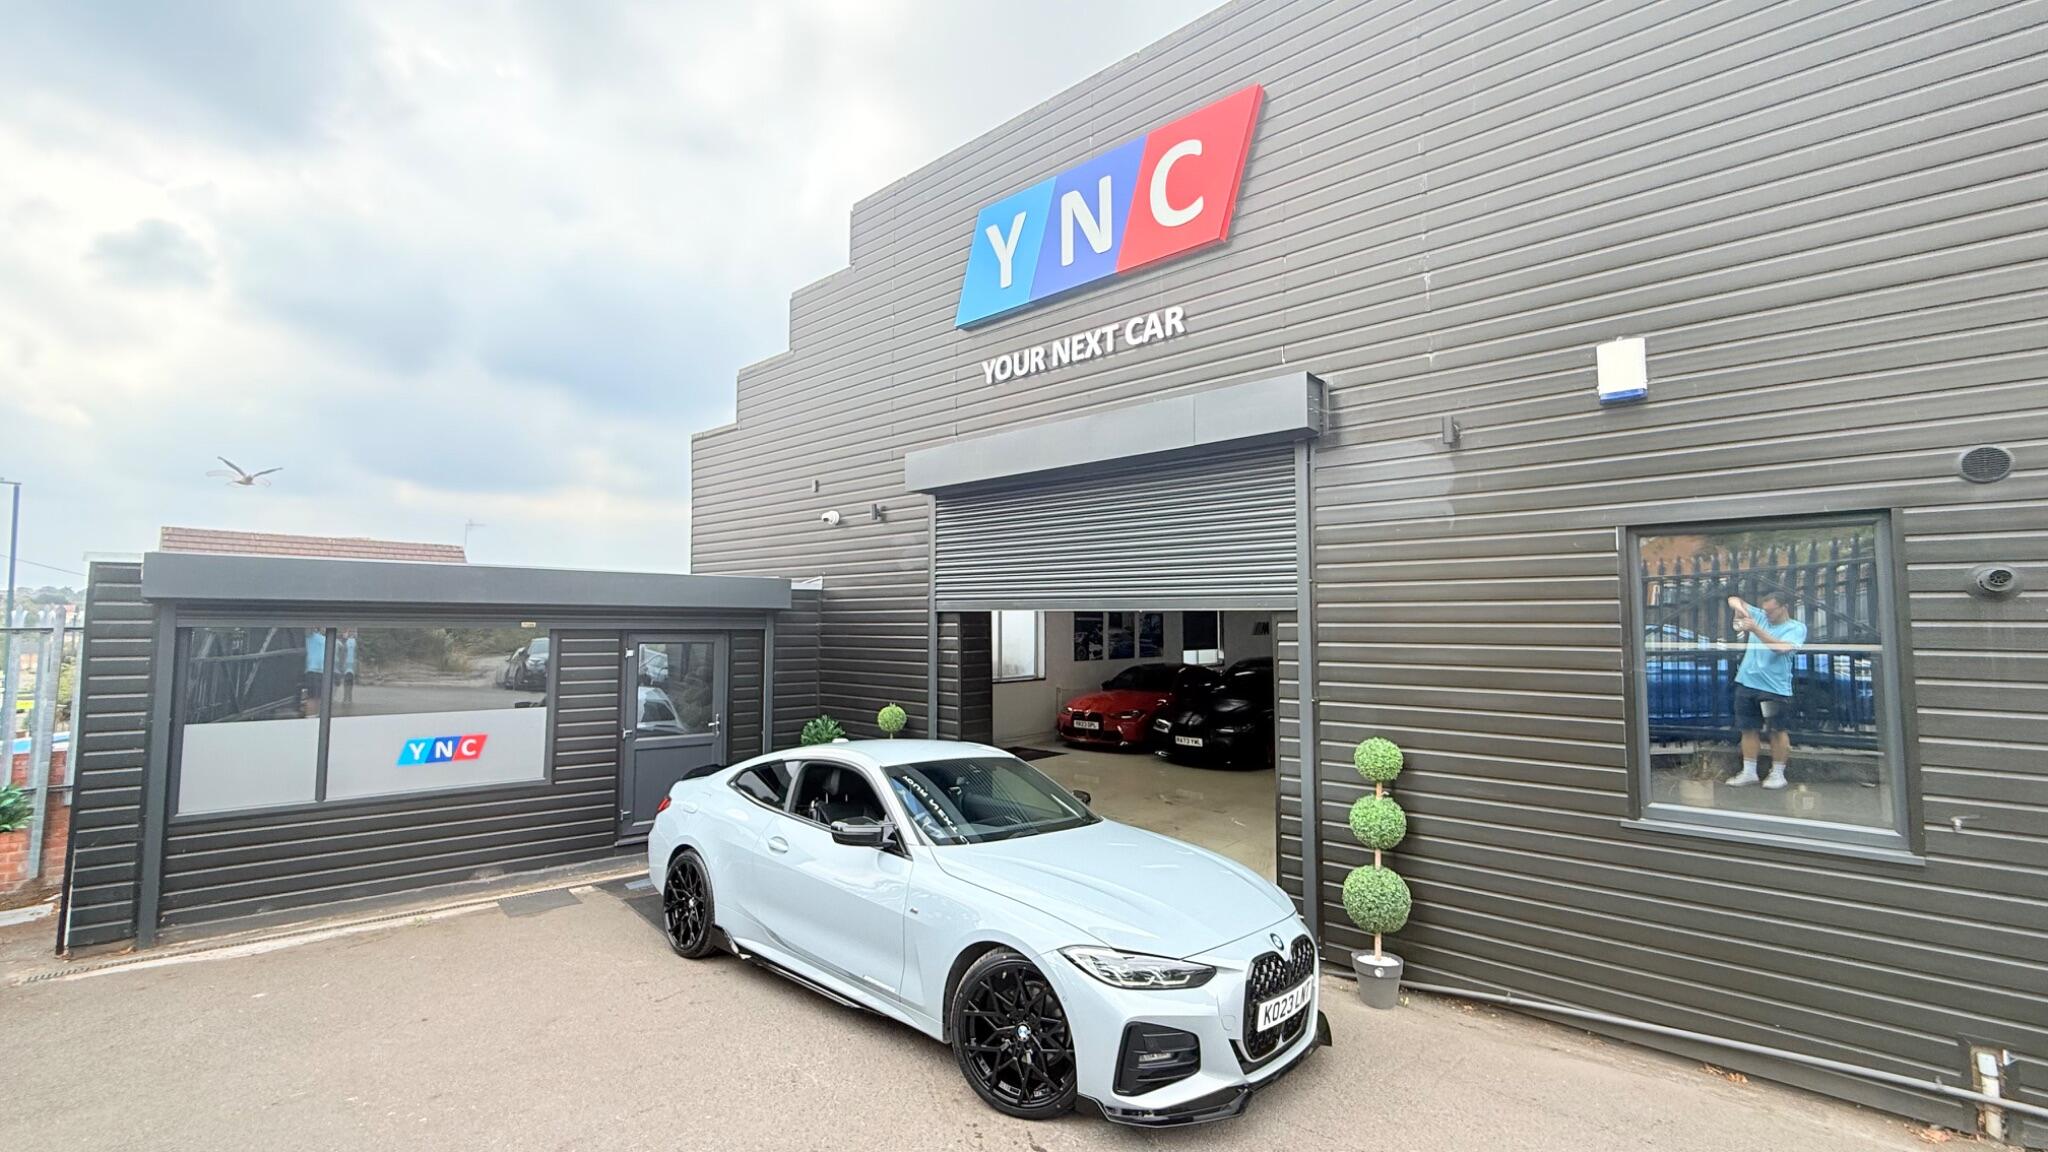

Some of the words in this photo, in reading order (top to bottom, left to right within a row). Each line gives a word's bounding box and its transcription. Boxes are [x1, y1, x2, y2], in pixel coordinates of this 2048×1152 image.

[985, 139, 1203, 288] YNC
[981, 346, 1045, 384] YOUR
[1052, 324, 1119, 363] NEXT
[1125, 306, 1185, 346] CAR
[409, 739, 477, 761] YNC
